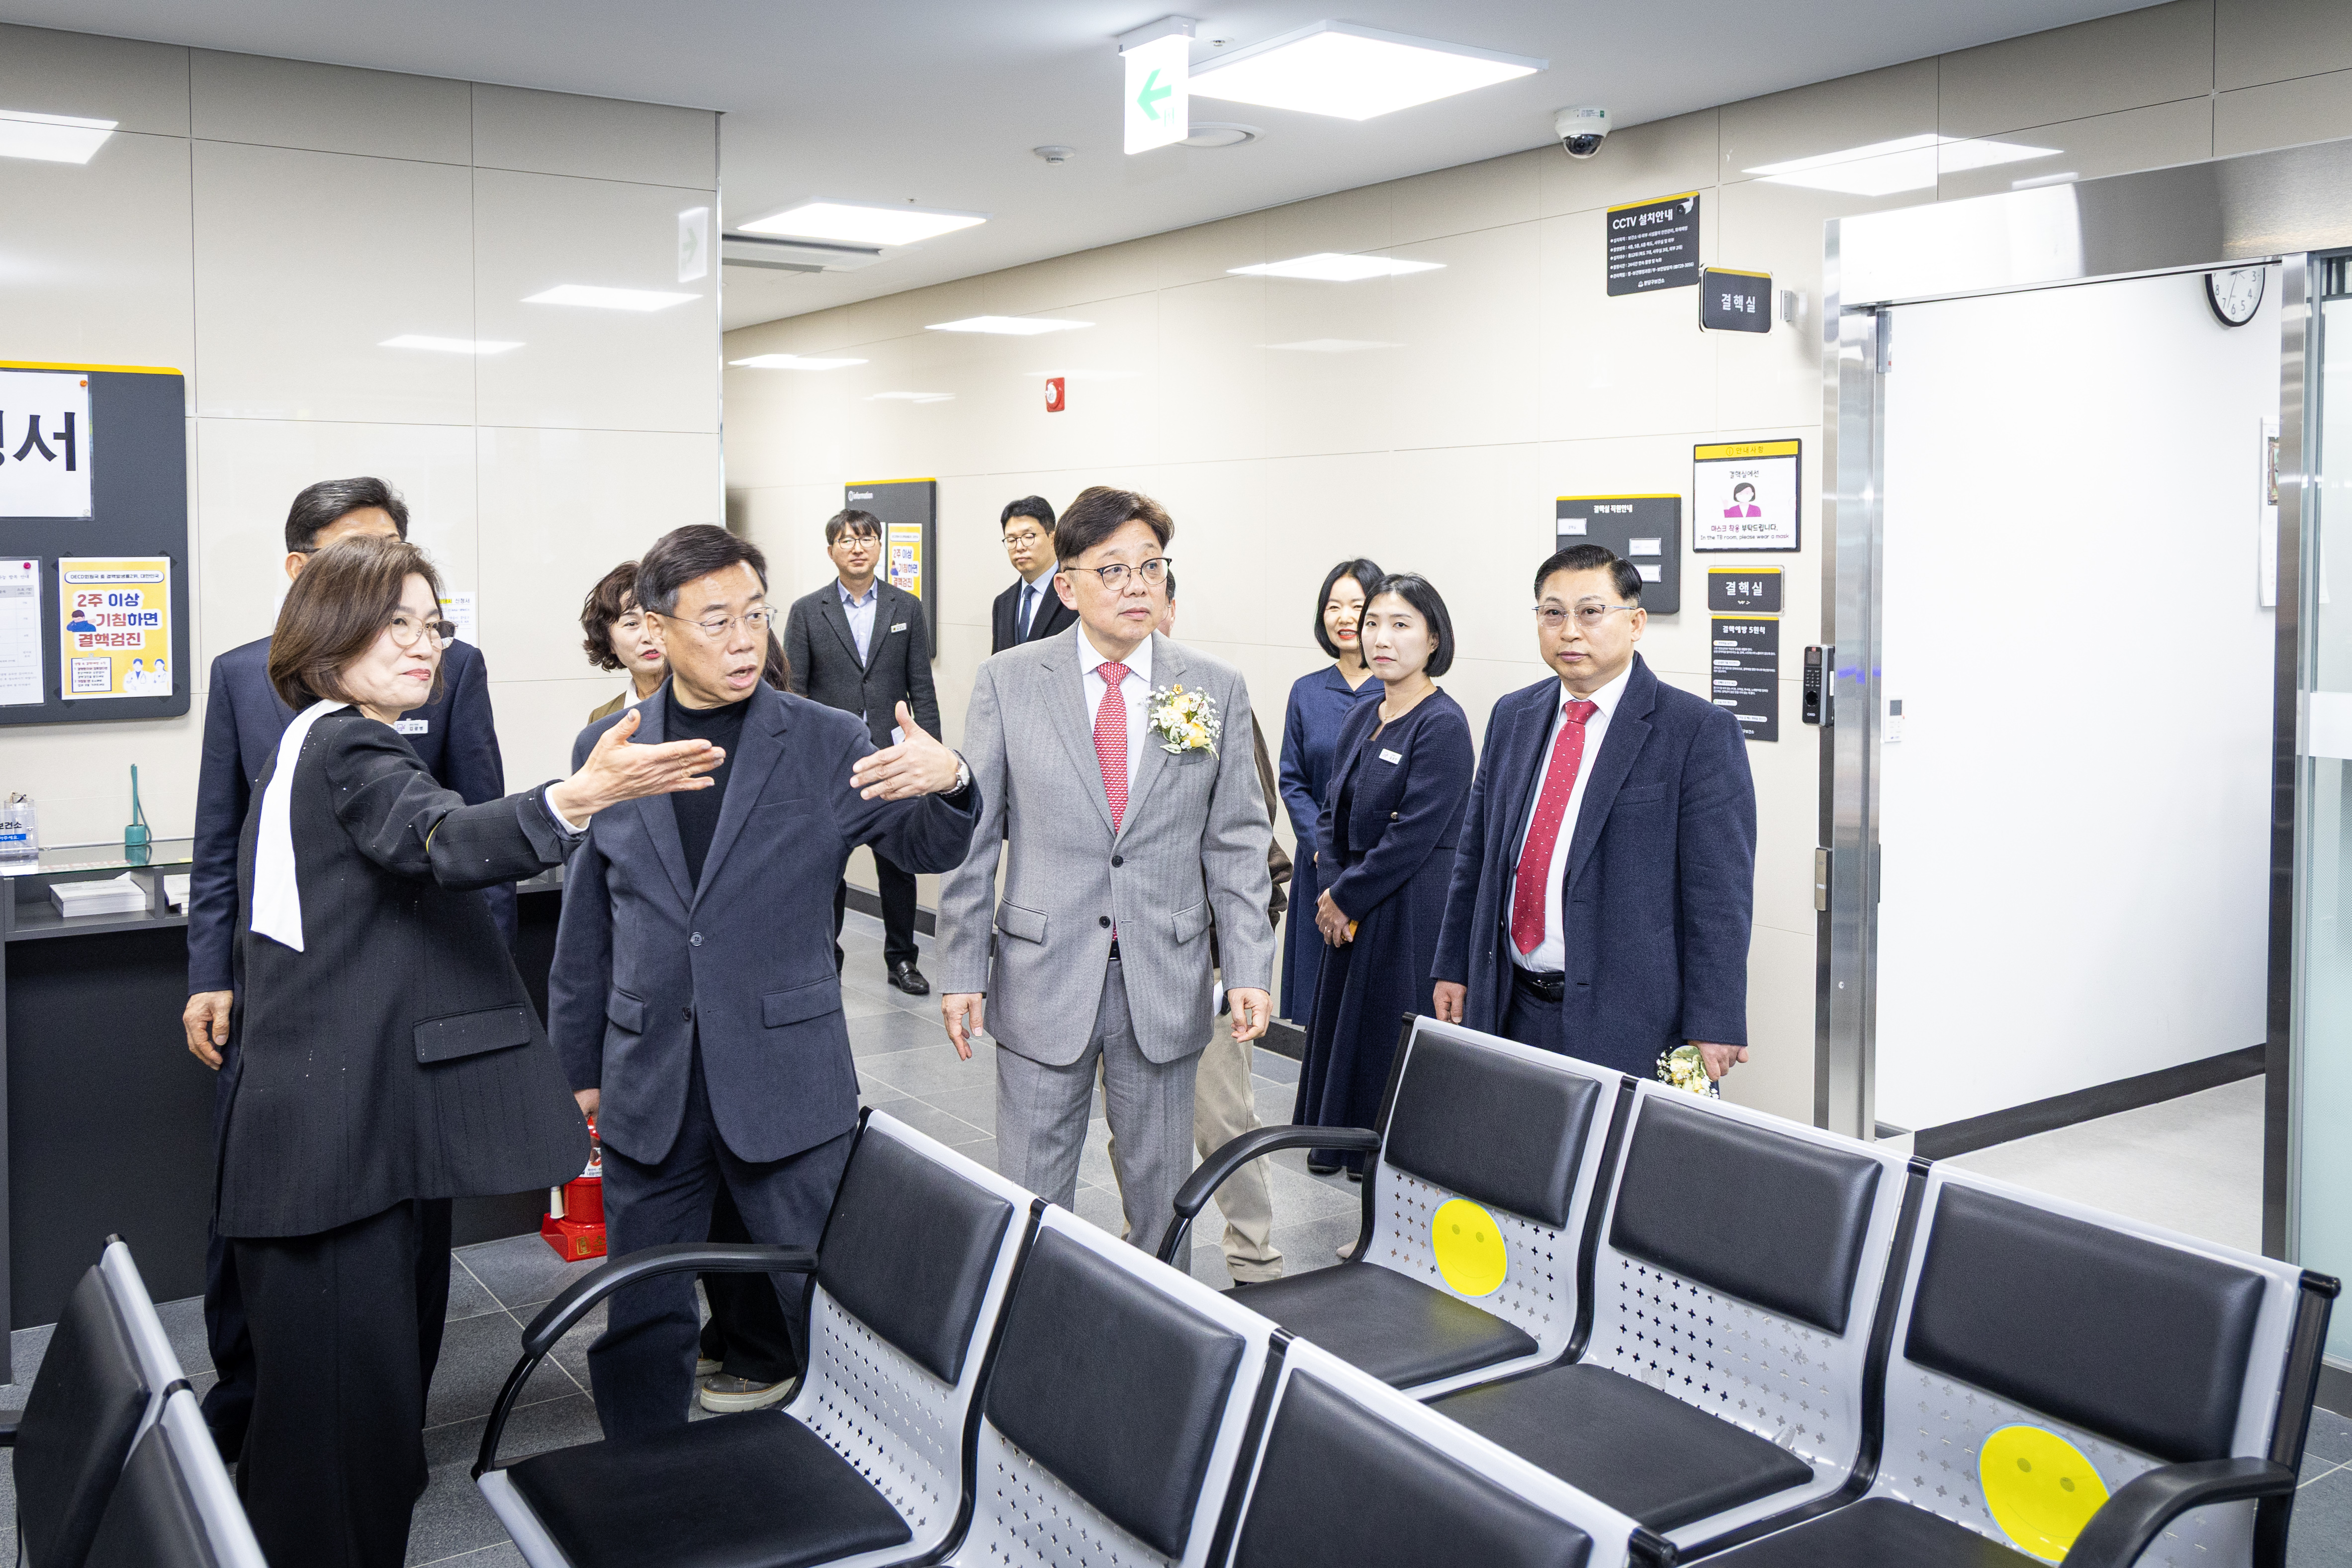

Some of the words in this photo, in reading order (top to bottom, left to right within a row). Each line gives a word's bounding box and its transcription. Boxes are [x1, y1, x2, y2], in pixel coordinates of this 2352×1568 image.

[1612, 216, 1637, 230] CCTV
[1638, 208, 1673, 226] 설치안내
[2252, 271, 2256, 281] 3
[2215, 284, 2219, 295] 8
[2248, 289, 2252, 298] 4
[1721, 293, 1756, 313] 결핵실
[2222, 298, 2226, 308] 7
[2241, 300, 2245, 310] 5
[2231, 304, 2235, 314] 6
[0, 409, 76, 471] 서
[1736, 446, 1764, 455] 안내사항
[1729, 470, 1759, 479] 결핵실에선
[1593, 504, 1610, 514] 결핵실
[1610, 504, 1633, 513] 직원안내
[1729, 524, 1739, 533] 착용
[1742, 524, 1778, 532] 부탁드립니다.
[893, 549, 901, 558] 2주
[903, 549, 912, 559] 이상
[899, 563, 918, 574] 기침하면
[894, 577, 912, 588] 결핵검진
[1725, 581, 1763, 596] 결핵실
[78, 594, 103, 607] 2주
[108, 593, 140, 607] 이상
[96, 612, 158, 627] 기침하면
[1722, 625, 1748, 634] 결핵예방
[1749, 626, 1766, 635] 5원칙
[79, 632, 141, 647] 결핵검진
